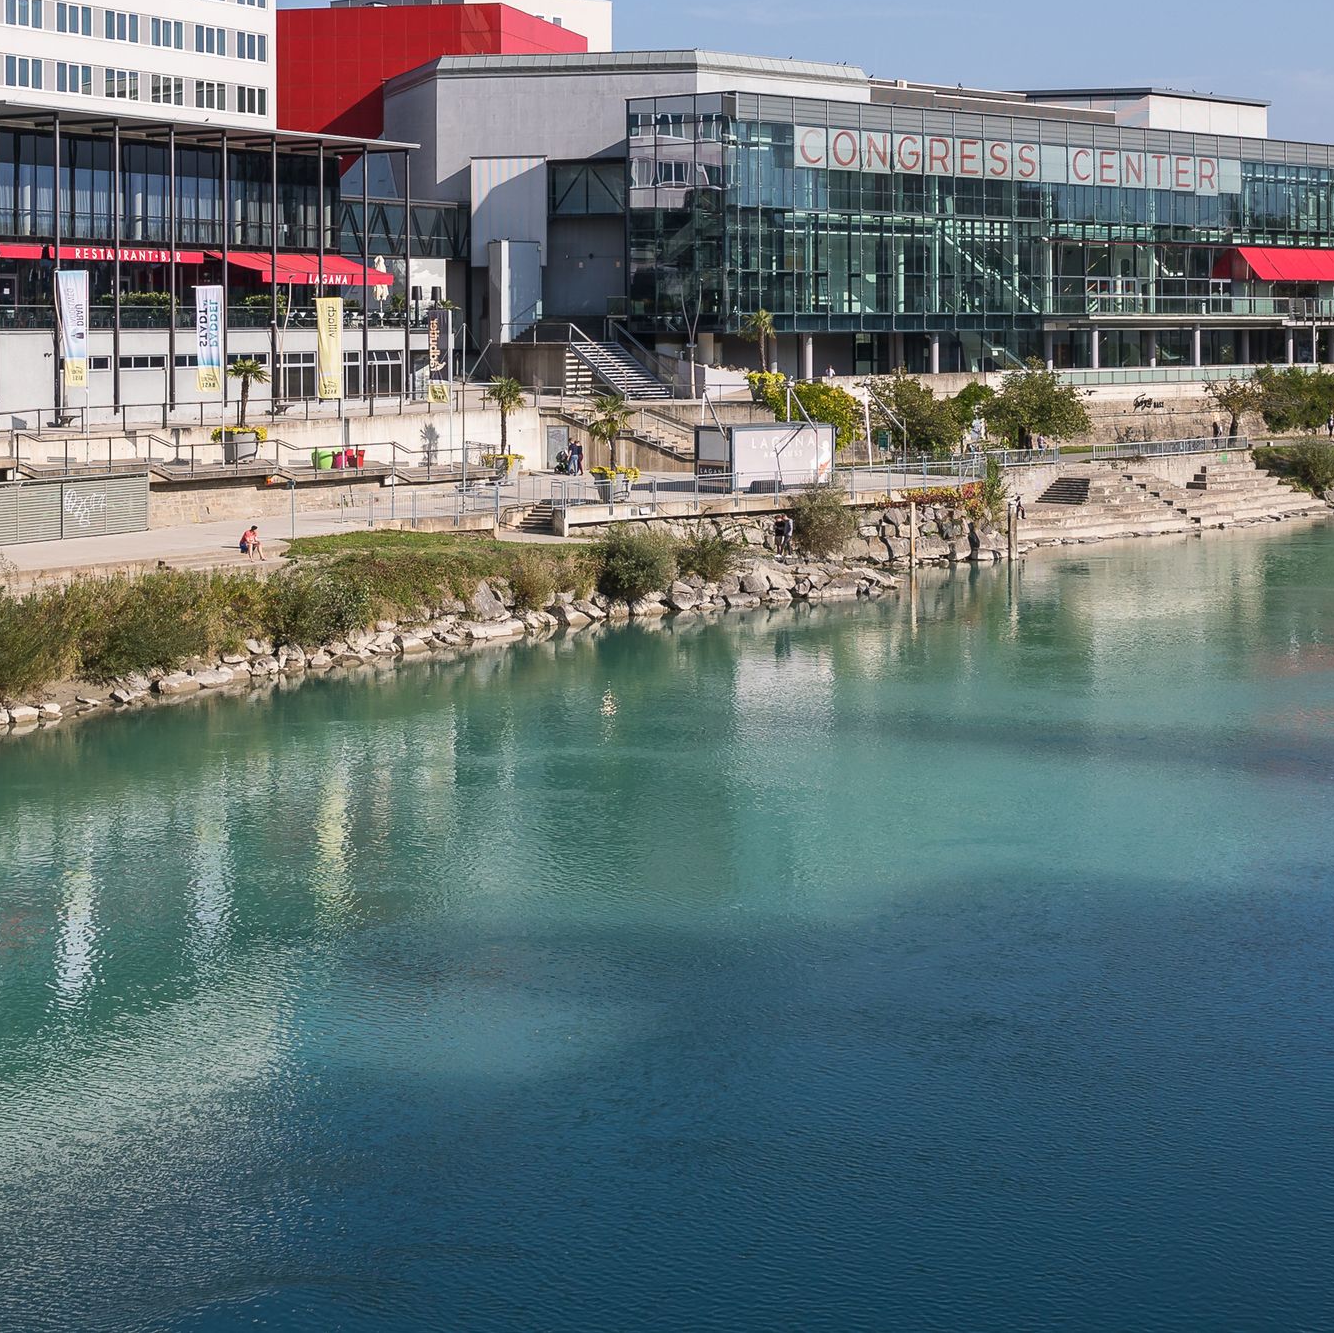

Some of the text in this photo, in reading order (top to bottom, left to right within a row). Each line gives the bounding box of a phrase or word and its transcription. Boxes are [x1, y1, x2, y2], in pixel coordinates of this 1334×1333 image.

[800, 129, 1217, 189] CONGRESS CENTER
[161, 251, 181, 262] BR
